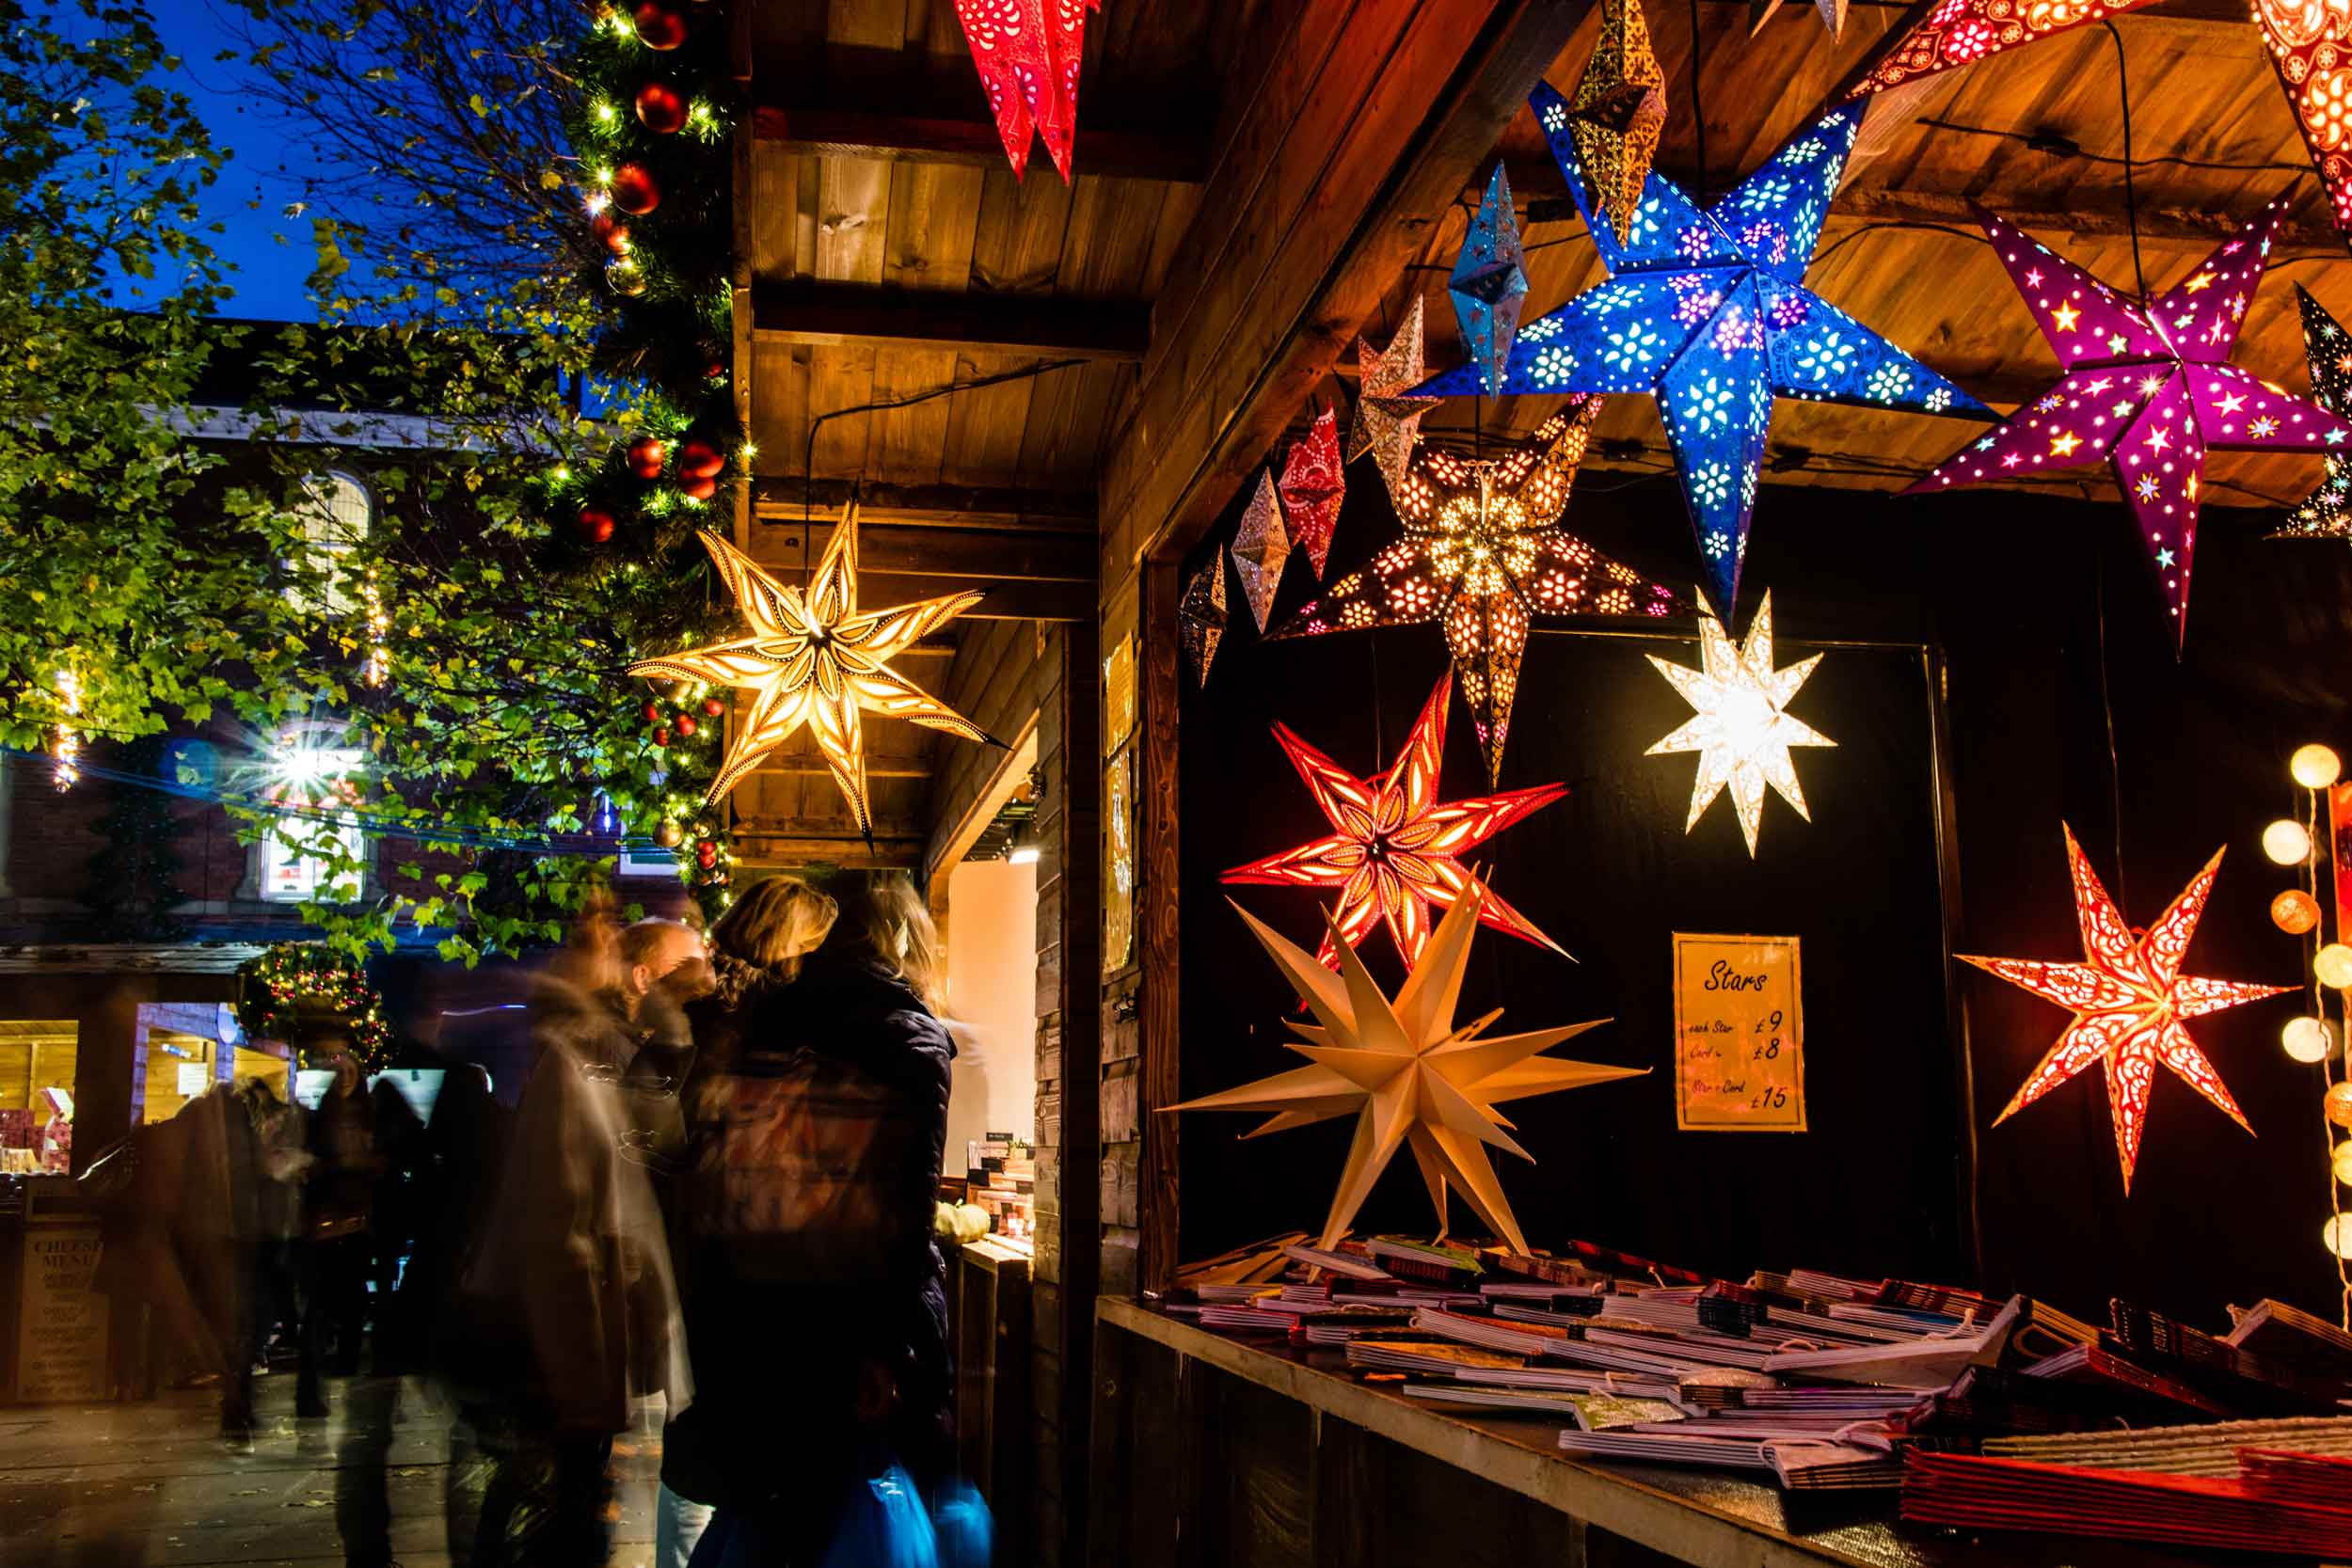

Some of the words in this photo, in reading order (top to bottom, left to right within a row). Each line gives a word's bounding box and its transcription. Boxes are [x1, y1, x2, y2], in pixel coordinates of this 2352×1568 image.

[1705, 959, 1767, 990] Stars
[1712, 1021, 1733, 1034] Star
[1751, 1086, 1788, 1109] £15
